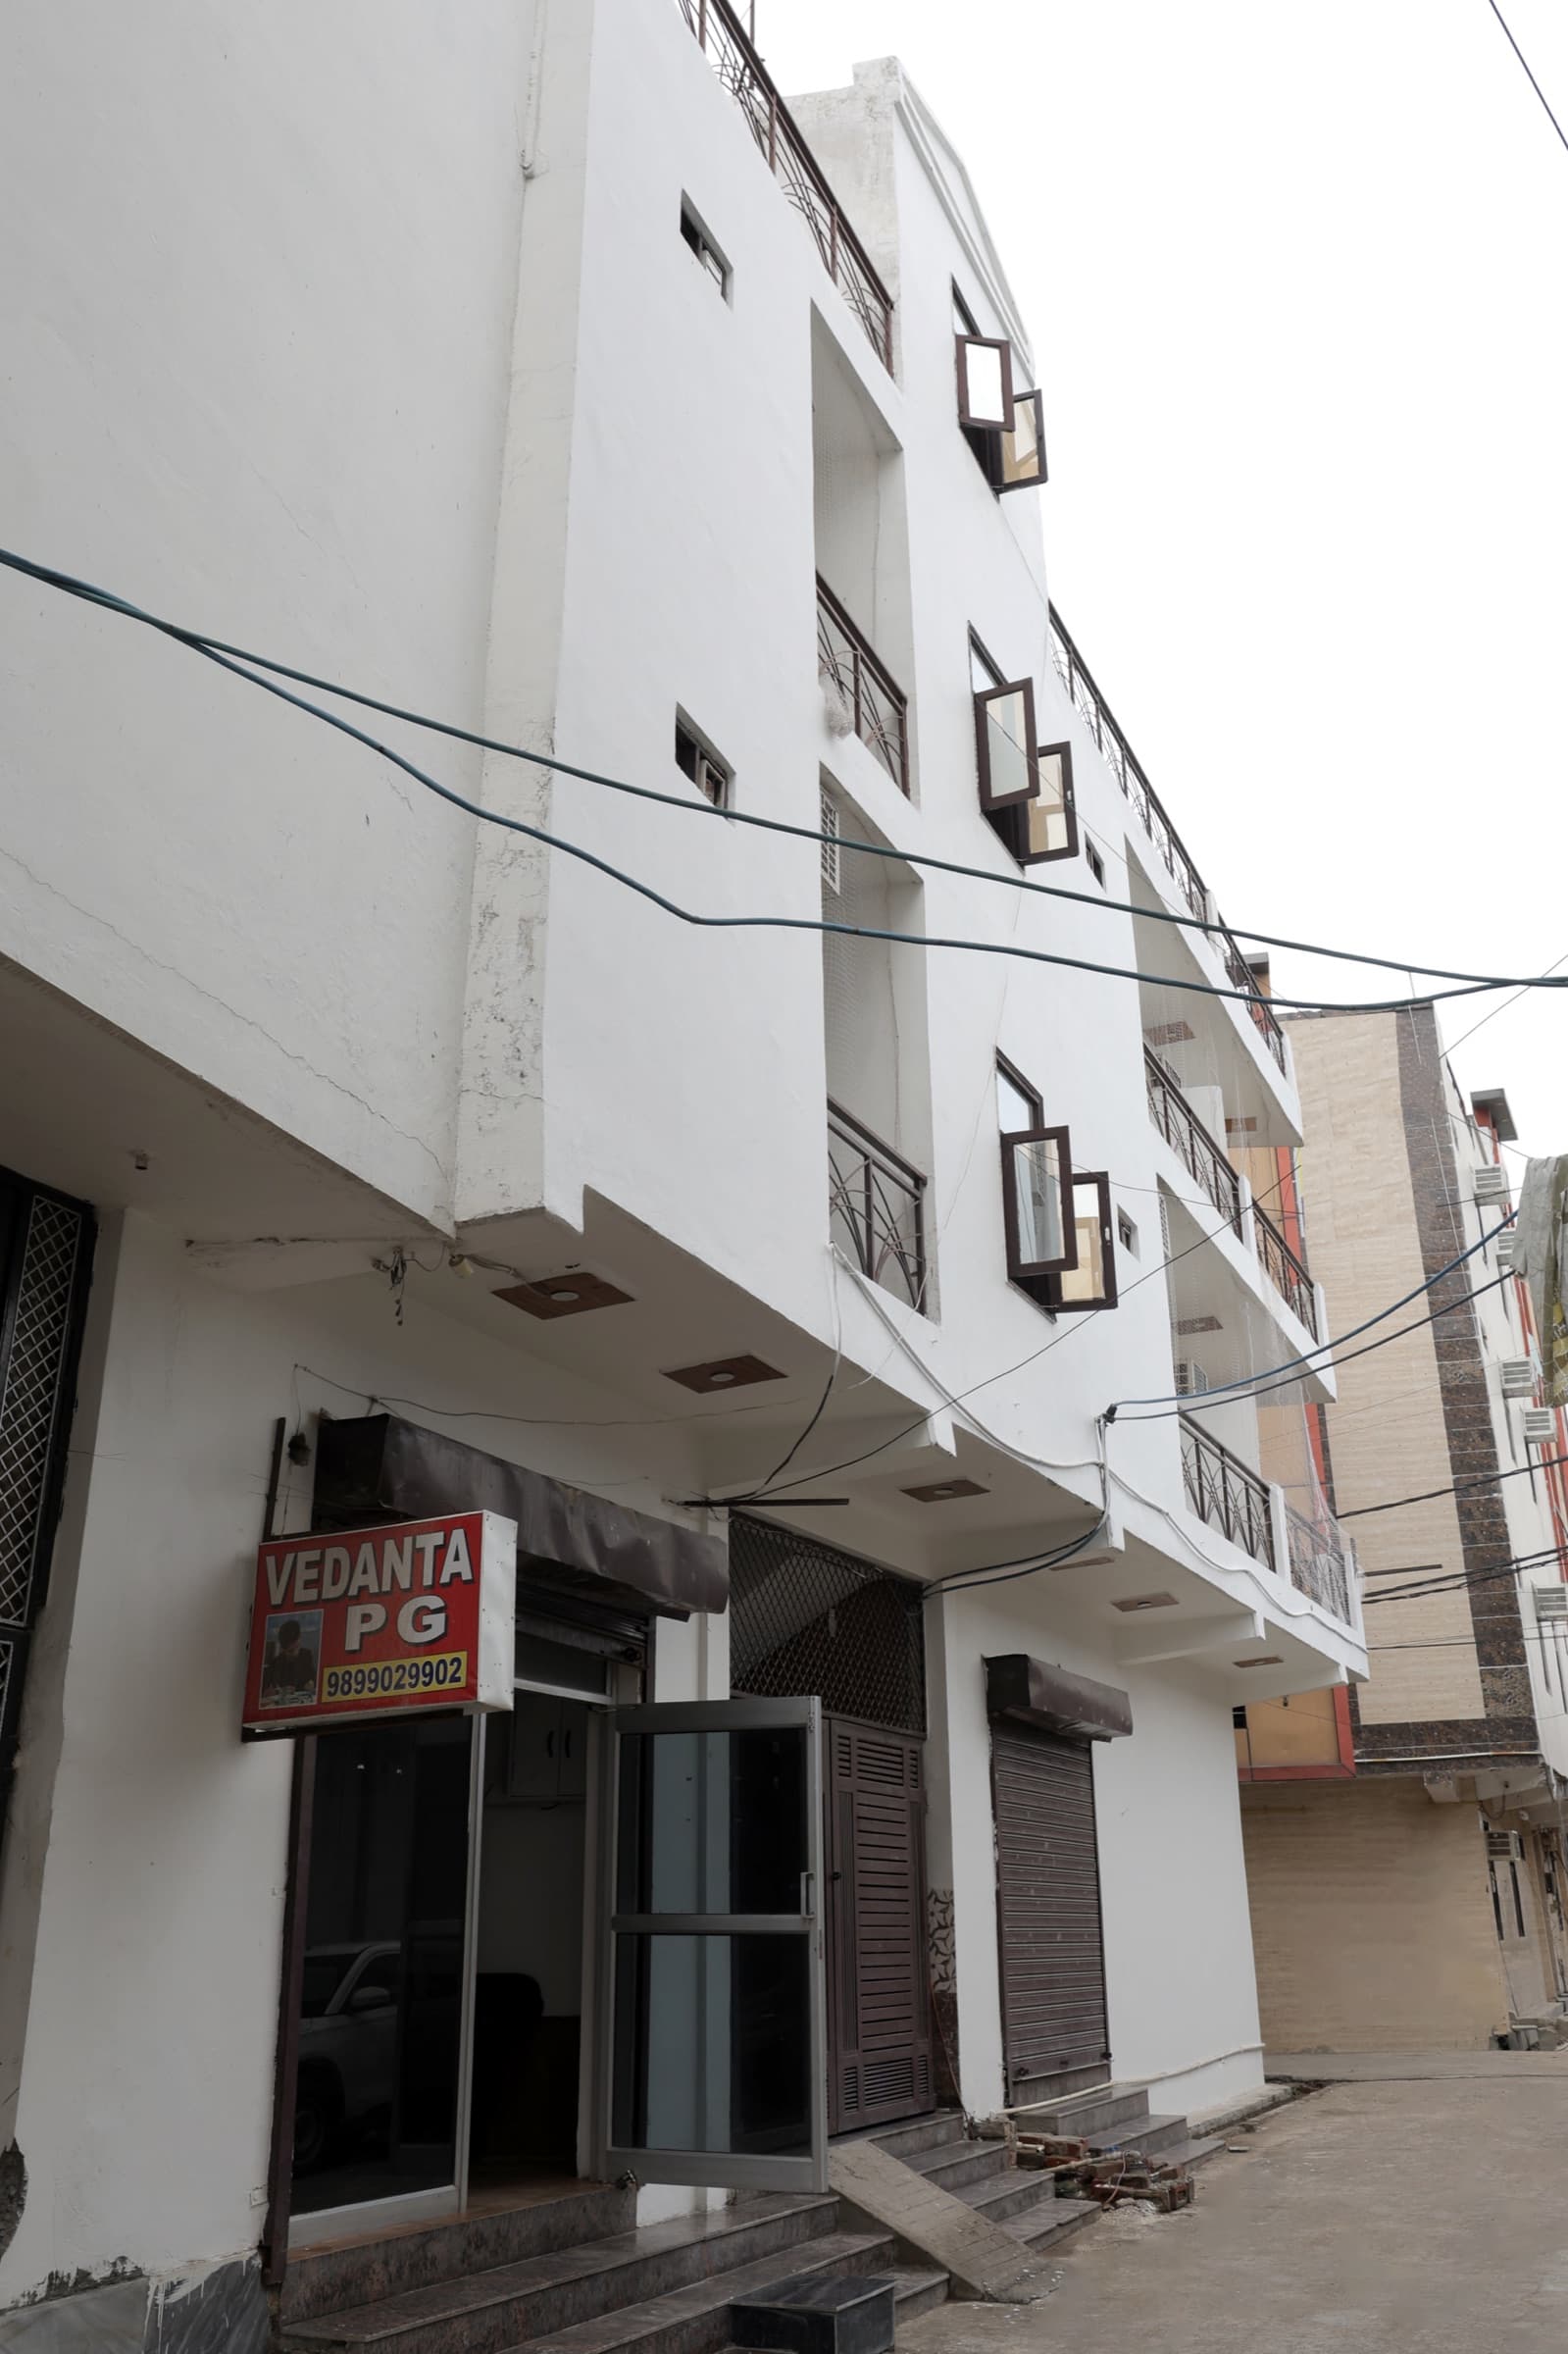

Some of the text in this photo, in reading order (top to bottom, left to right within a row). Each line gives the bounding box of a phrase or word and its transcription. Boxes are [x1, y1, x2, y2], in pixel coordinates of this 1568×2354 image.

[266, 1528, 473, 1606] VEDANTA
[344, 1595, 447, 1652] PG
[328, 1657, 463, 1697] 9899029902
